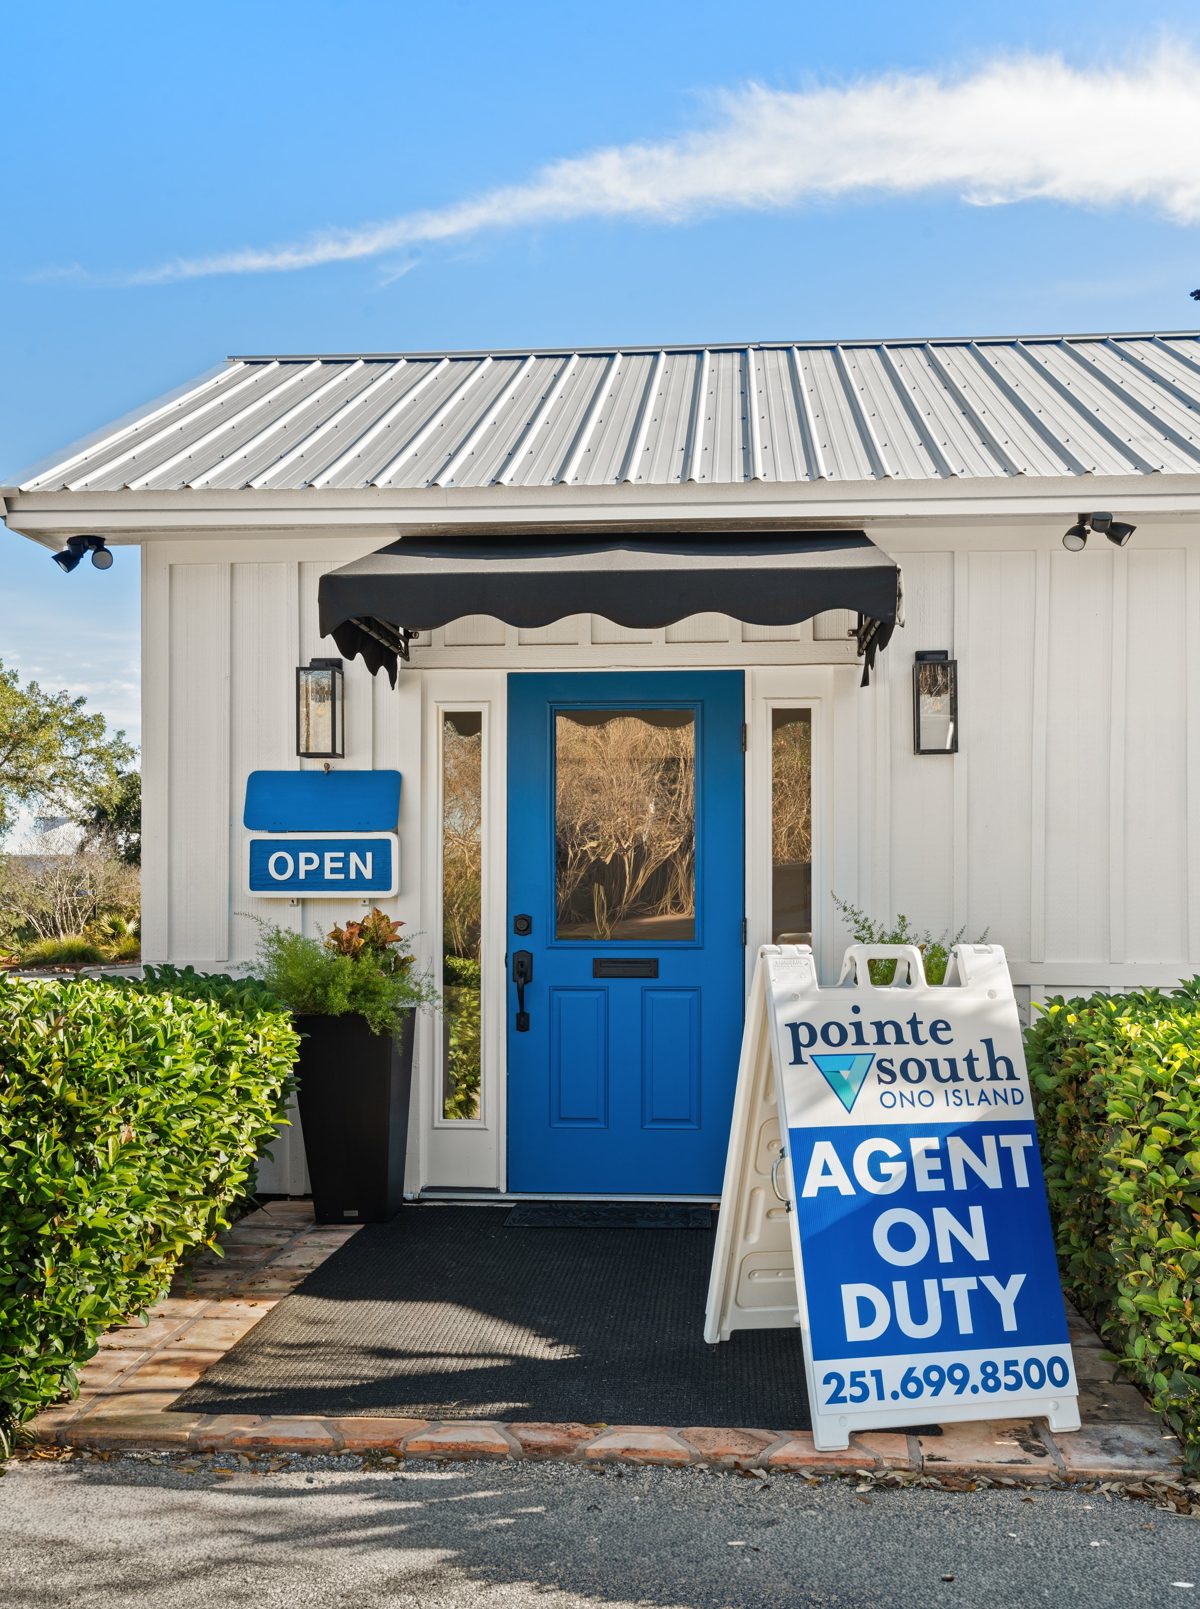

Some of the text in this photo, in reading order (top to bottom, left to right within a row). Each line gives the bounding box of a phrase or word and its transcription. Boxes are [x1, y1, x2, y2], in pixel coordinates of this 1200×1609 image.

[268, 851, 373, 881] OPEN
[785, 1005, 953, 1065] pointe
[876, 1037, 1020, 1085] south
[879, 1087, 1025, 1109] ONO ISLAND
[801, 1133, 1033, 1198] AGENT
[872, 1205, 991, 1267] ON
[840, 1273, 1027, 1343] DUTY
[822, 1356, 1070, 1405] 251.699.8500
